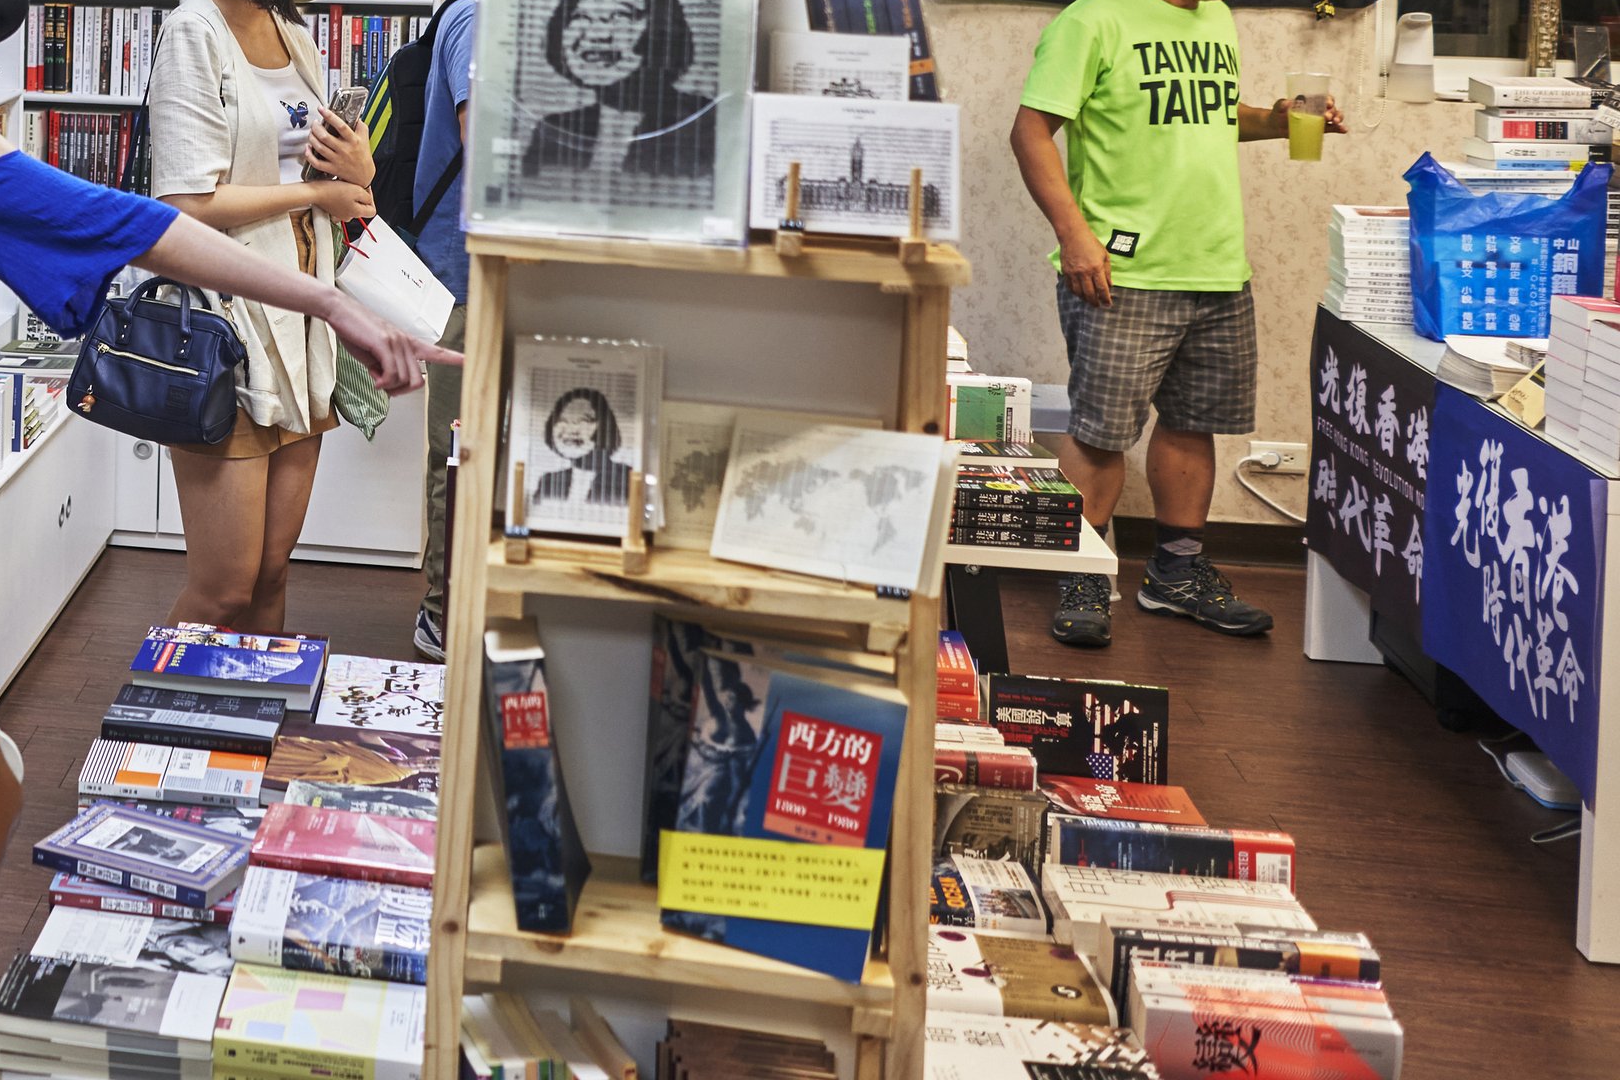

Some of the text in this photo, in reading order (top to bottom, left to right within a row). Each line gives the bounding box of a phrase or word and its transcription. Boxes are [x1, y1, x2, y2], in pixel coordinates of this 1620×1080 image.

[1132, 40, 1239, 76] TAIWAN
[1317, 415, 1334, 440] FREE
[1349, 439, 1369, 468] KONG
[1482, 560, 1585, 724] 時代革命
[996, 706, 1072, 728] 美國說了算
[788, 721, 873, 765] 西方的
[777, 751, 868, 814] 巨變
